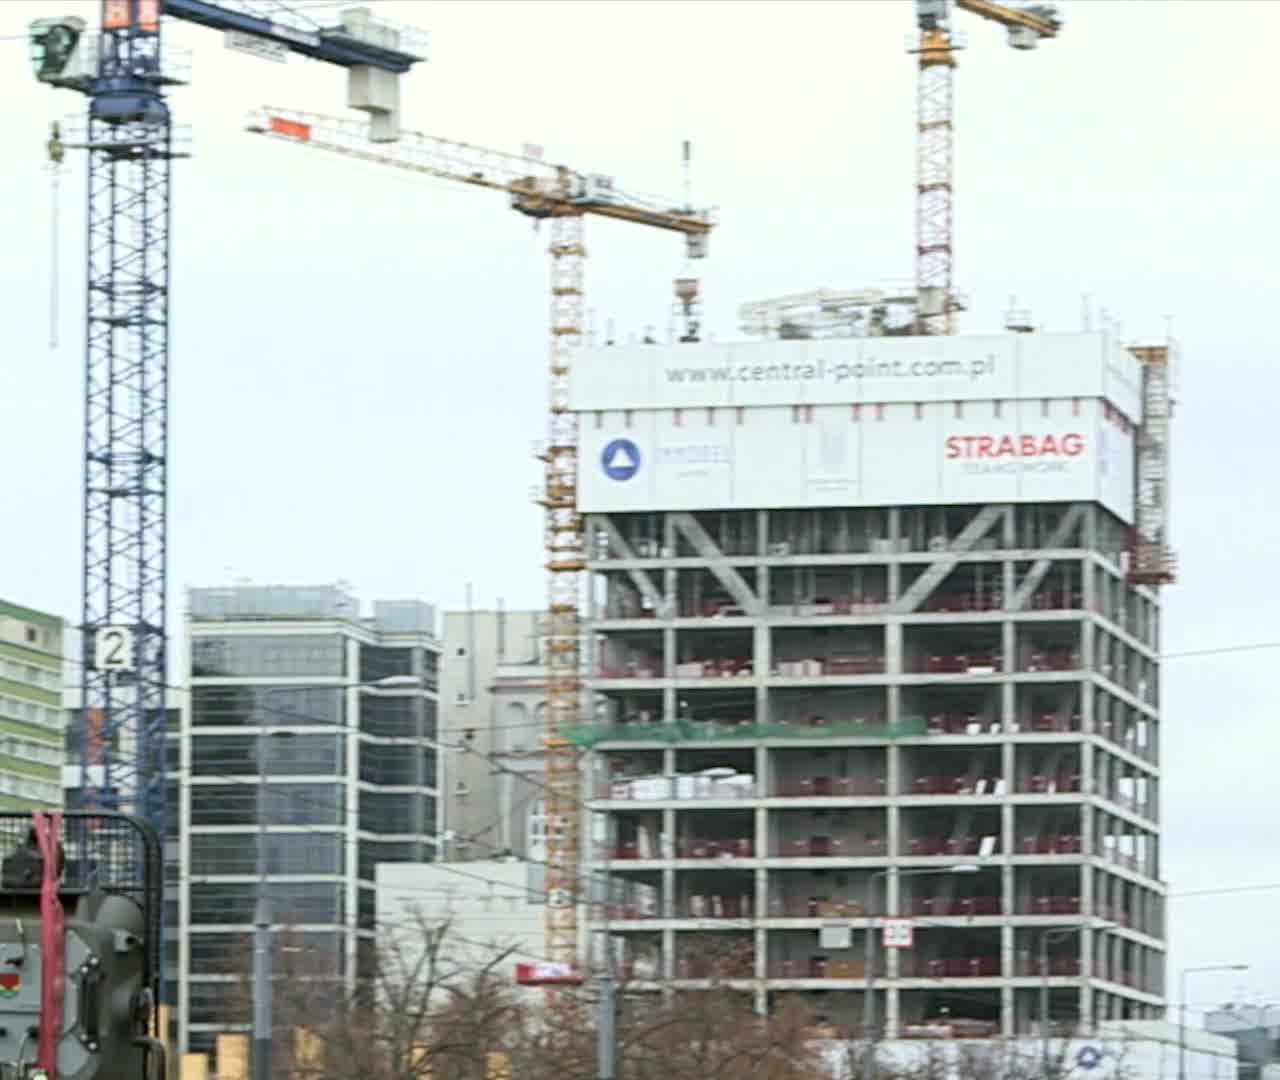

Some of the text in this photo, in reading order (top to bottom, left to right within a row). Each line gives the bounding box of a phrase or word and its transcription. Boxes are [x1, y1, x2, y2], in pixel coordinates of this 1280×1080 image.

[665, 354, 996, 384] www.central-point.com.pl
[945, 433, 1087, 460] STRABAG
[104, 631, 124, 664] 2
